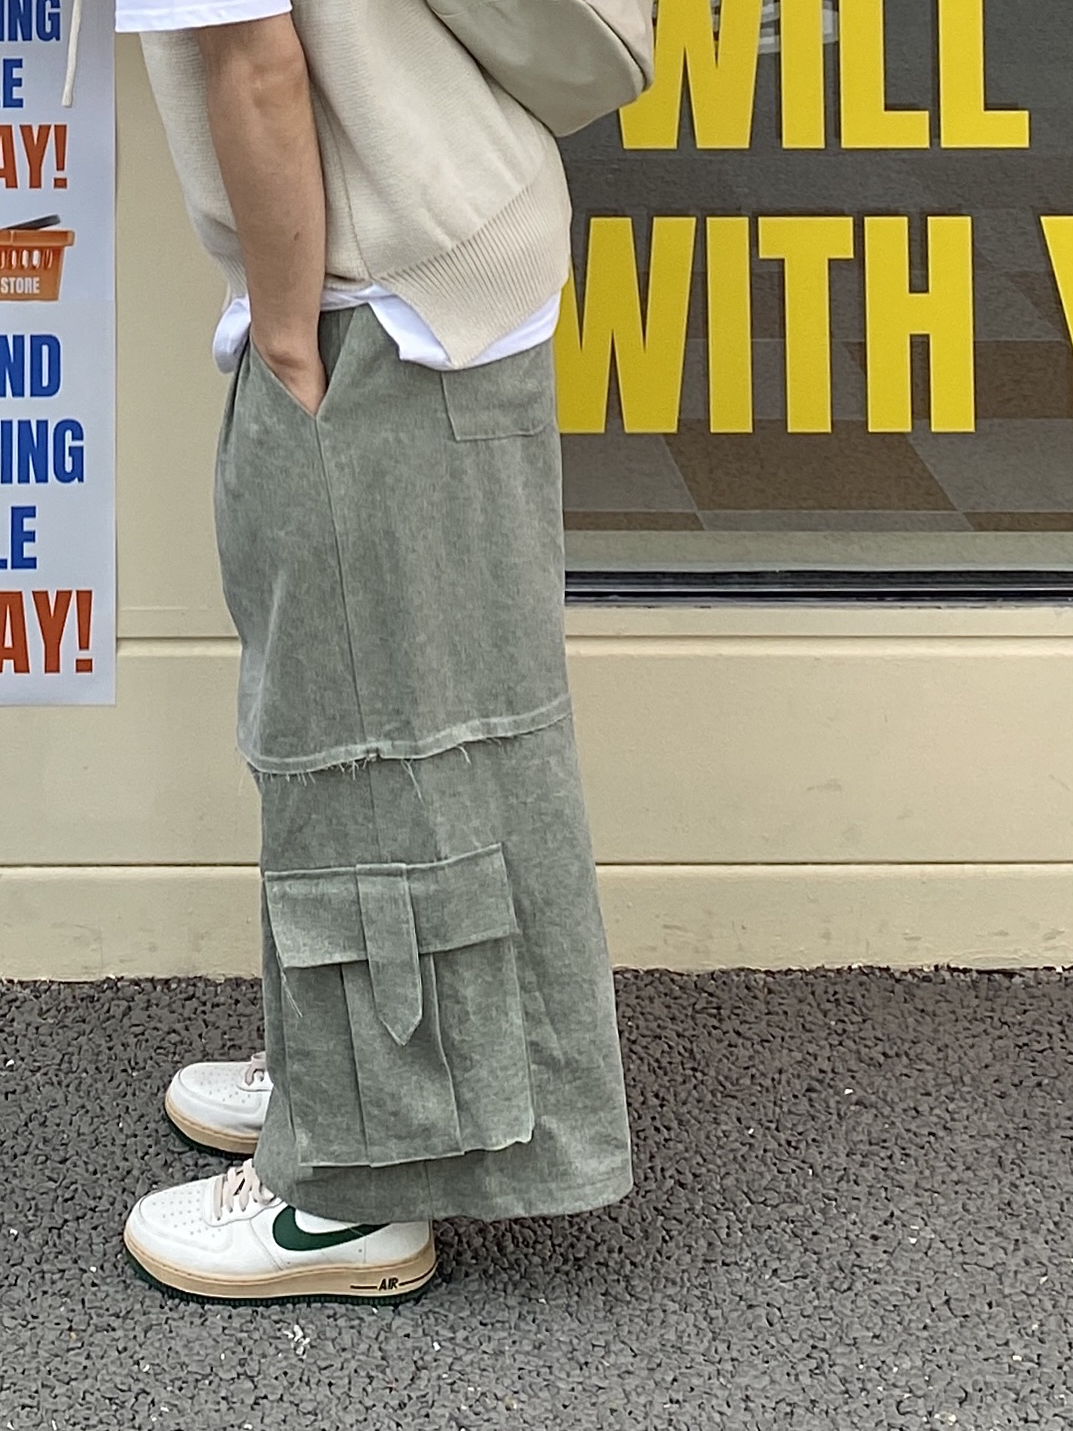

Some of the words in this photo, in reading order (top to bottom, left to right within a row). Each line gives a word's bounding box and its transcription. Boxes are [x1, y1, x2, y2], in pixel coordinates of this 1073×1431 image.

[0, 276, 40, 294] STORE
[553, 215, 975, 433] WITH
[378, 1277, 399, 1292] AIR
